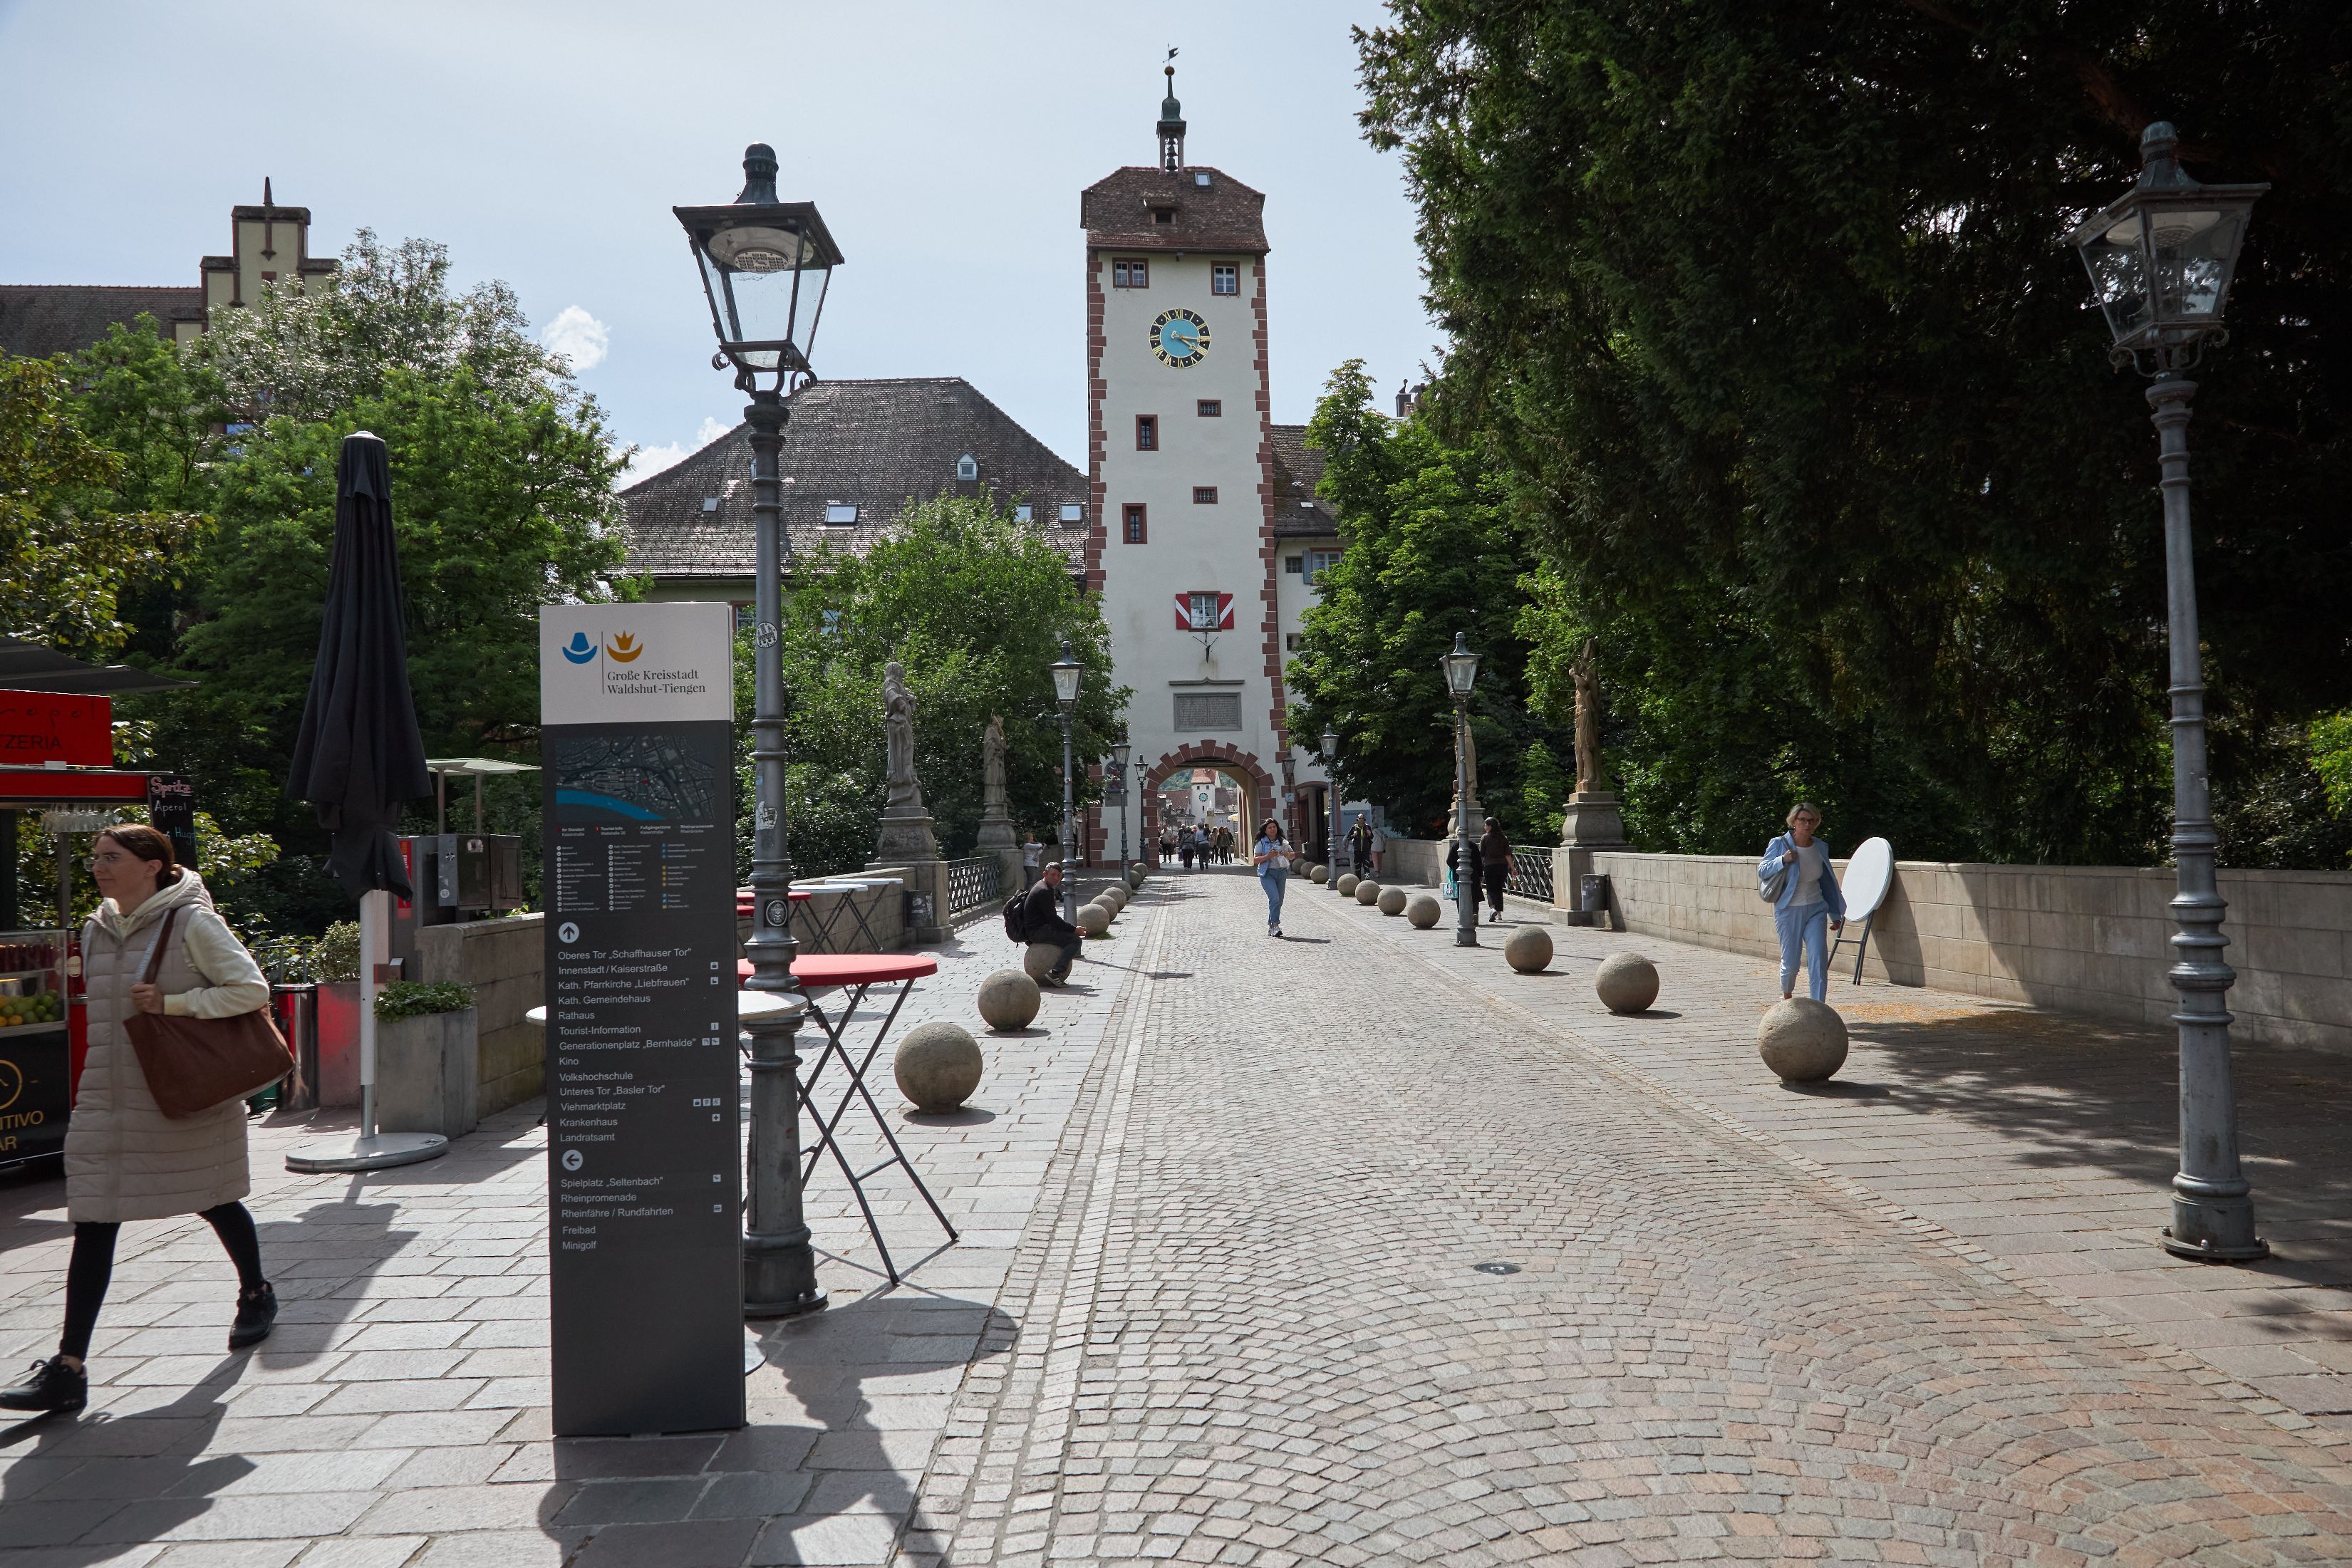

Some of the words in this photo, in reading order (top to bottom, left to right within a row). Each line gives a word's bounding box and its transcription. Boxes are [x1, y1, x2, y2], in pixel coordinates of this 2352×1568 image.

[607, 670, 641, 681] Große
[643, 669, 700, 680] Kreisstadt
[607, 683, 706, 695] Waldshut-Tiengen
[150, 776, 192, 798] Spritz
[154, 800, 187, 817] Aperol
[558, 951, 591, 960] Oberes
[593, 950, 607, 960] Tor
[609, 949, 672, 960] „Schaffhauser
[559, 965, 605, 975] Innenstadt
[606, 965, 610, 974] /
[611, 964, 668, 974] Kaiserstraße
[559, 981, 581, 990] Kath.
[584, 980, 632, 990] Pfarrkirche
[559, 996, 581, 1005] Kath.
[584, 995, 651, 1004] Gemeindehaus
[559, 1011, 596, 1020] Rathaus
[559, 1025, 641, 1035] Tourist-Information
[559, 1040, 641, 1051] Generationenplatz
[559, 1056, 579, 1066] Kino
[559, 1071, 633, 1081] Volkshochschule
[560, 1086, 595, 1096] Unteres
[596, 1086, 611, 1096] Tor
[613, 1086, 645, 1096] „Basler
[561, 1102, 626, 1112] Viehmarktplatz
[560, 1117, 618, 1127] Krankenhaus
[560, 1133, 616, 1142] Landratsamt
[561, 1178, 604, 1190] Spielplatz
[561, 1193, 637, 1204] Rheinpromenade
[561, 1209, 610, 1218] Rheinfähre
[611, 1208, 616, 1217] /
[618, 1207, 673, 1217] Rundfahrten
[562, 1225, 596, 1235] Freibad
[562, 1240, 597, 1252] Minigolf
